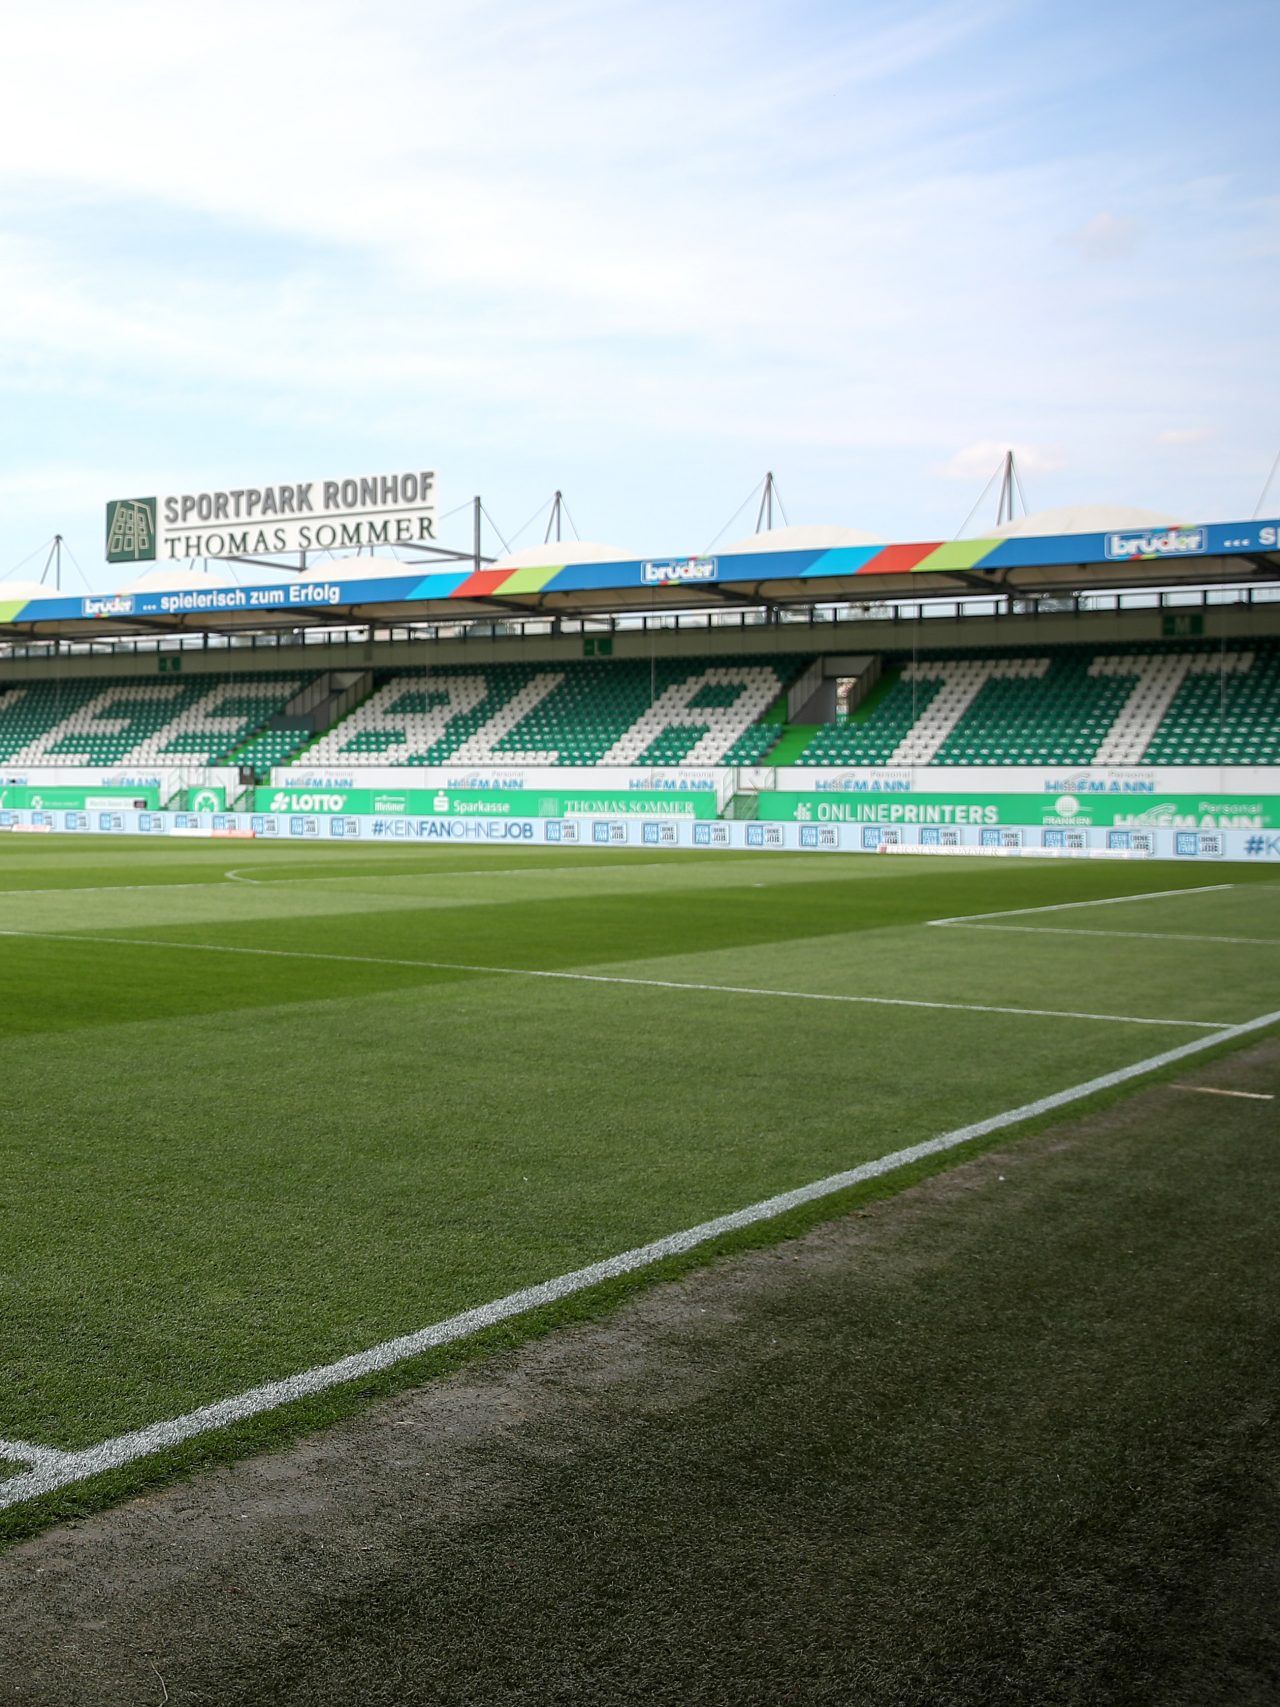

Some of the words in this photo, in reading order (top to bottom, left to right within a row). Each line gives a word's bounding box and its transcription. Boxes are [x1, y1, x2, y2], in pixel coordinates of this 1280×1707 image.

[164, 483, 313, 524] SPORTPARK
[323, 471, 435, 510] RONHOF
[164, 528, 287, 560] THOMAS
[298, 517, 438, 549] SOMMER
[160, 588, 247, 613] spielerisch
[250, 586, 285, 604] zum
[288, 583, 341, 605] Erfolg
[291, 793, 343, 812] LOTTO
[453, 799, 510, 814] Sparkasse
[564, 800, 625, 813] THOMAS
[629, 800, 695, 813] SOMMER
[1199, 802, 1264, 815] Personal
[817, 803, 1000, 824] ONLINEPRINTERS
[372, 819, 534, 840] #KEINFANOHNEJOB
